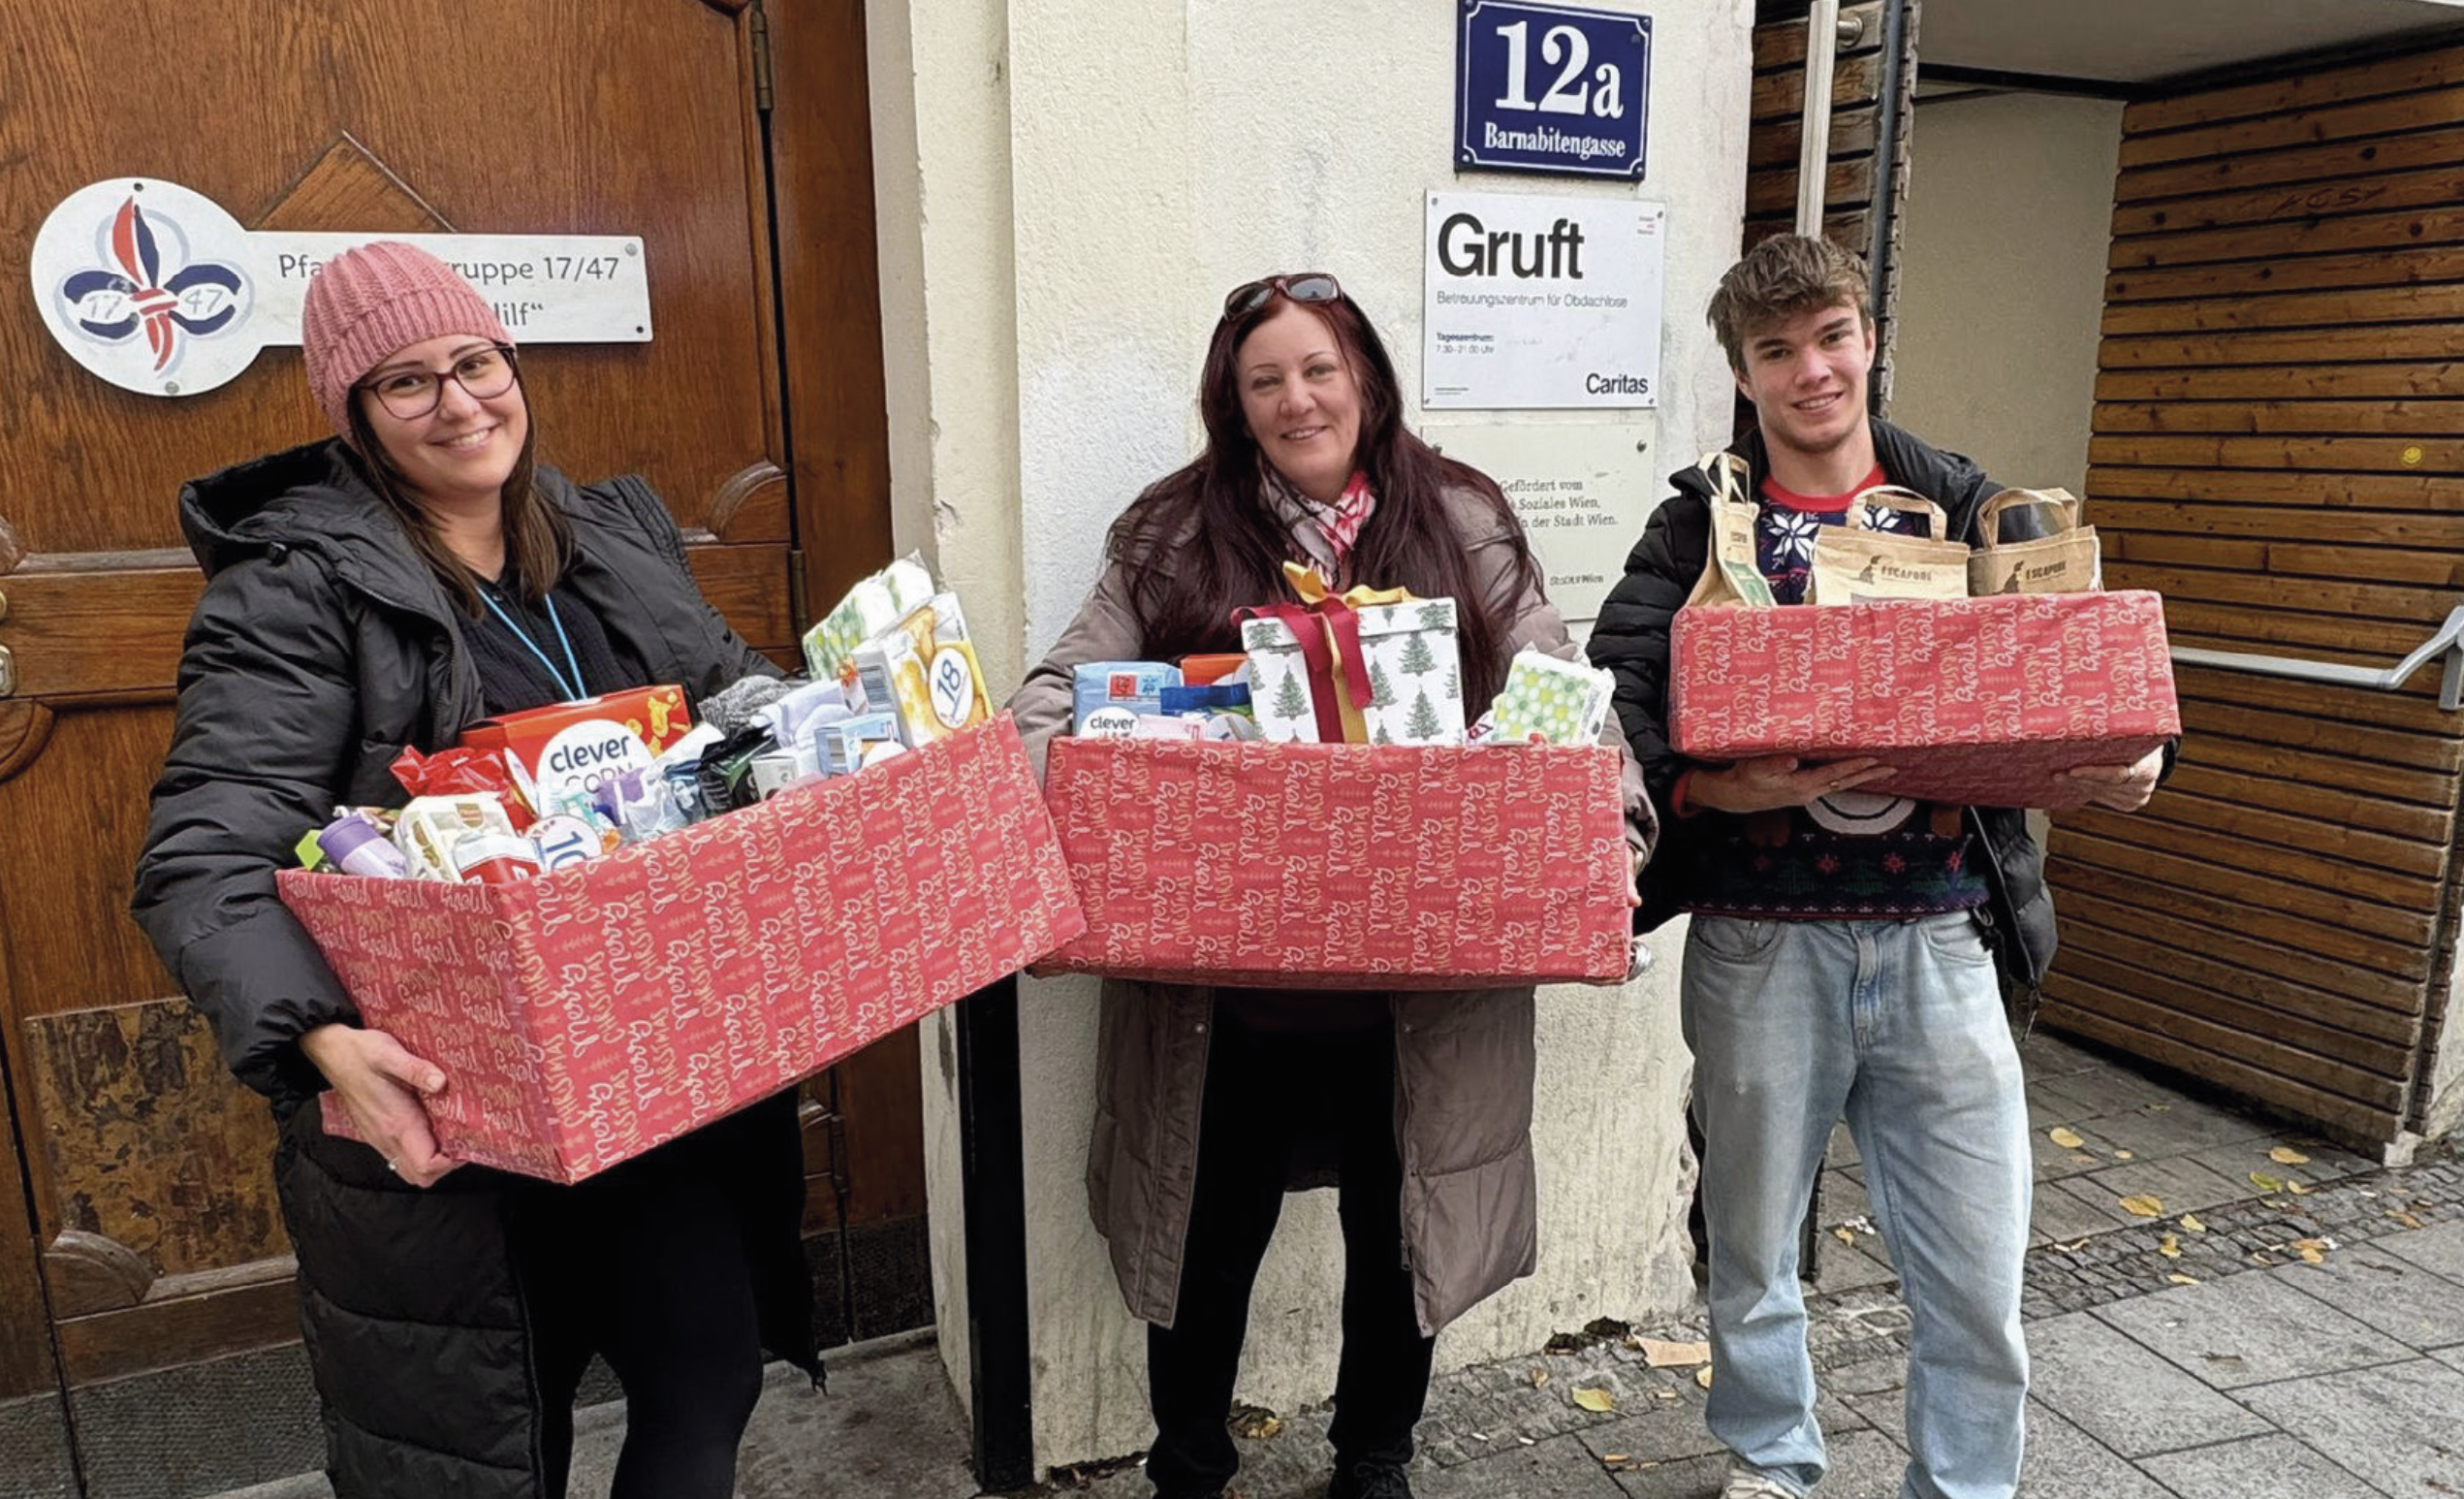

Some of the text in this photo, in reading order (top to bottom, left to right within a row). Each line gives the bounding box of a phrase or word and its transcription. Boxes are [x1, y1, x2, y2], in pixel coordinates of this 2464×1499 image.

[1495, 20, 1625, 119] 12a
[1485, 121, 1627, 160] Barnabitengasse
[278, 254, 619, 285] Pfa ruppe 17/47
[1437, 212, 1585, 279] Gruft
[184, 289, 223, 314] 47
[1437, 291, 1627, 309] Betreuungszentrum für Obdachlose
[1586, 372, 1649, 395] Caritas
[1519, 497, 1566, 511] Soziales
[1532, 515, 1551, 528] der
[1554, 514, 1584, 527] Stadt
[1560, 481, 1583, 491] vom
[1708, 620, 1731, 685] Merry
[1789, 627, 1814, 693] Merry
[1872, 631, 1896, 698] Merry
[1911, 599, 1935, 662] Merry
[1995, 601, 2019, 667] Merry
[2076, 606, 2101, 671] Merry
[936, 658, 962, 702] 18
[1954, 636, 1978, 702] Merry
[2038, 641, 2063, 706] Merry
[2124, 646, 2149, 711] Merry
[1090, 717, 1136, 730] clever
[1746, 673, 1771, 739] Merry
[1830, 680, 1853, 745] Merry
[550, 735, 630, 773] clever
[1010, 752, 1036, 823] Merry
[1196, 748, 1221, 818] Merry
[1587, 745, 1609, 813] Merry
[898, 777, 924, 856] Merry
[959, 763, 984, 840] Merry
[1067, 769, 1093, 839] Merry
[1153, 781, 1178, 852] Merry
[1239, 794, 1265, 865] Merry
[1283, 760, 1309, 832] Merry
[1371, 773, 1399, 844] Merry
[1458, 782, 1485, 854] Merry
[1543, 792, 1569, 864] Merry
[824, 789, 853, 874] Merry
[999, 813, 1023, 889] Merry
[1107, 829, 1133, 900] Merry
[1326, 807, 1354, 877] Merry
[1415, 818, 1441, 889] Merry
[1501, 828, 1528, 899] Merry
[873, 845, 899, 926] Merry
[940, 828, 966, 907] Merry
[982, 862, 1004, 938] Merry
[1034, 847, 1065, 917] Merry
[1193, 843, 1219, 912] Merry
[1280, 856, 1308, 924] Merry
[1367, 867, 1395, 936] Merry
[1586, 838, 1610, 908] Merry
[703, 881, 738, 970] Merry
[792, 862, 823, 947] Merry
[841, 899, 869, 980] Merry
[918, 880, 942, 958] Merry
[1151, 877, 1175, 945] Merry
[1237, 889, 1263, 956] Merry
[1323, 901, 1350, 968] Merry
[1455, 877, 1482, 946] Merry
[1540, 887, 1567, 956] Merry
[601, 902, 641, 995] Merry
[759, 917, 790, 1005] Merry
[1410, 908, 1437, 974] Merry
[560, 964, 600, 1058] Merry
[666, 940, 700, 1031] Merry
[809, 971, 837, 1052] Merry
[889, 948, 913, 1028] Merry
[627, 1020, 663, 1110] Merry
[723, 994, 755, 1080] Merry
[587, 1083, 625, 1169] Merry
